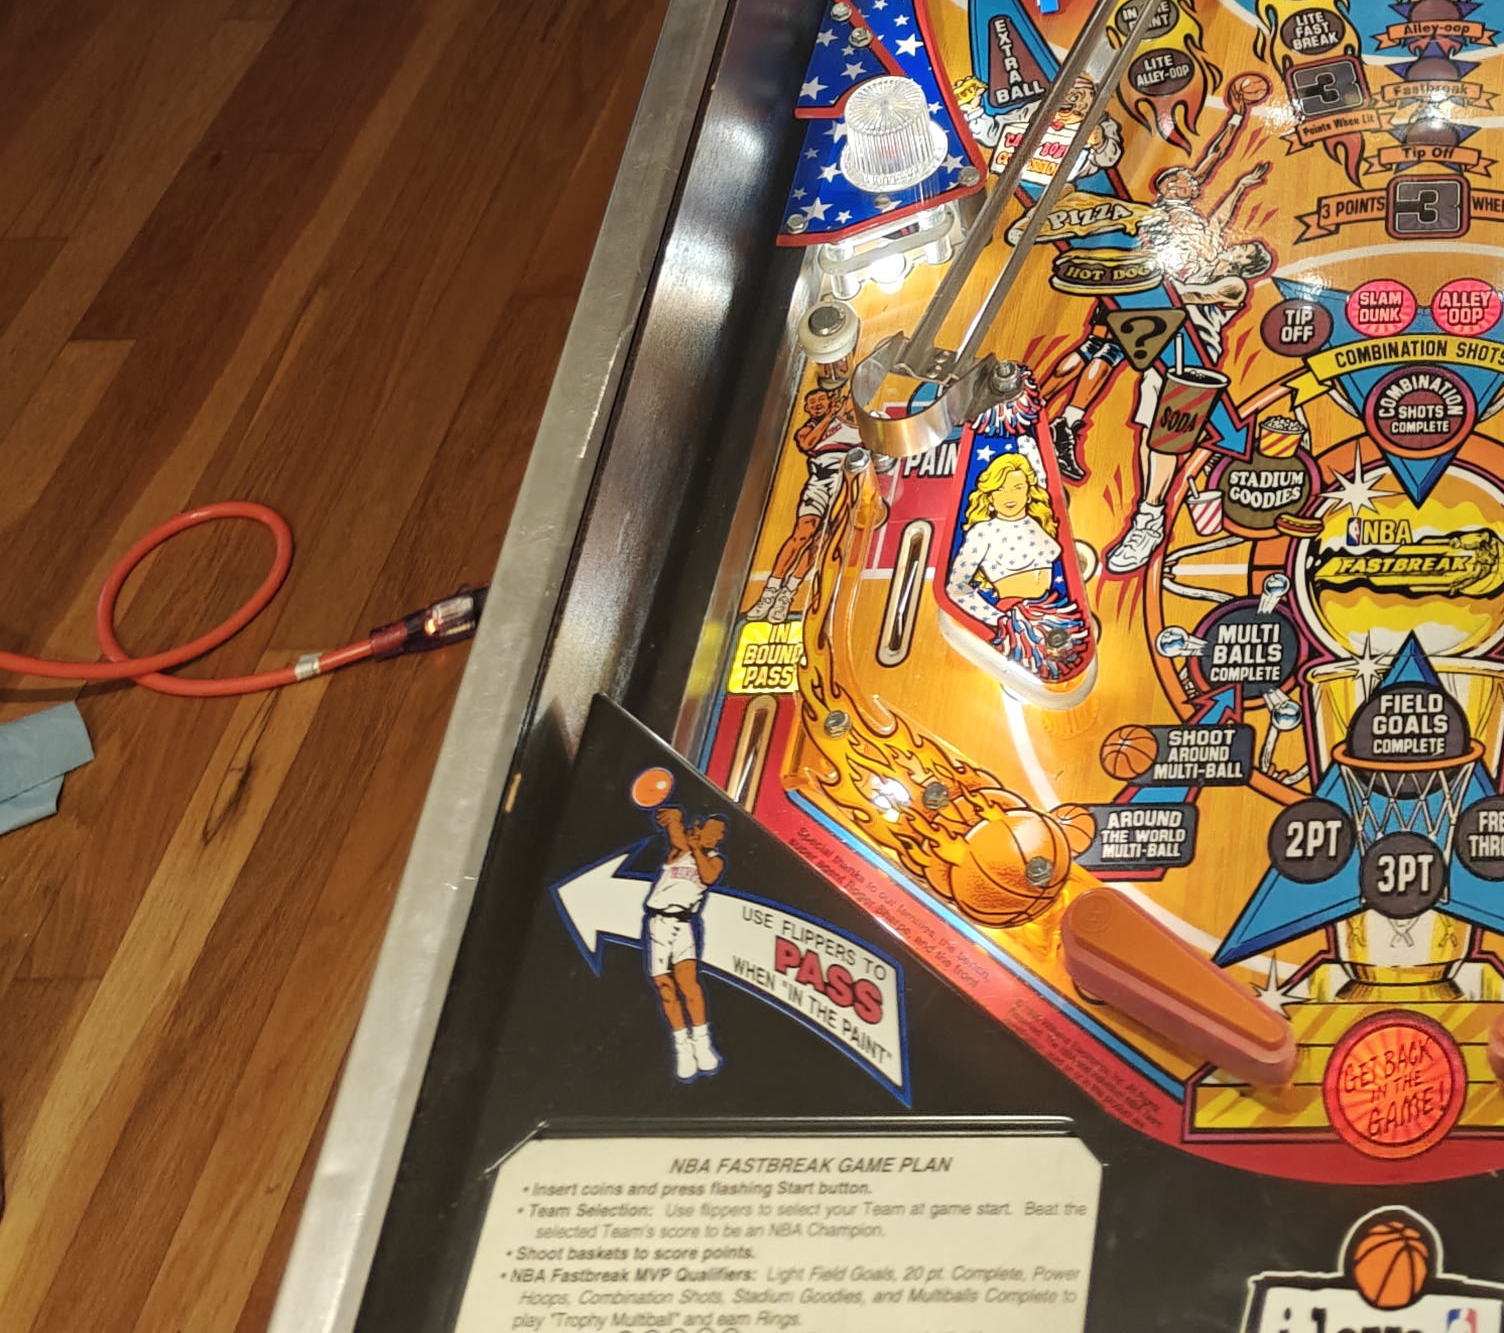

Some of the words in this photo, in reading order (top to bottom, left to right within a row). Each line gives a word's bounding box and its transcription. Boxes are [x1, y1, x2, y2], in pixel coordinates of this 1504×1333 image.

[1295, 11, 1325, 27] LITE
[1295, 22, 1330, 38] FAST
[1292, 32, 1340, 51] BREAK
[1144, 55, 1173, 70] LITE
[1136, 64, 1190, 87] ALLEY-OOP
[996, 77, 1045, 105] BALL
[1402, 146, 1427, 160] Tip
[1430, 145, 1456, 159] Off
[1047, 203, 1133, 230] PIZZA
[1321, 202, 1334, 220] 3
[1337, 196, 1386, 216] POINTS
[1359, 291, 1403, 307] SLAM
[1438, 291, 1492, 308] ALLEY
[1285, 308, 1314, 326] TIP
[1359, 307, 1402, 325] DUNK
[1450, 307, 1484, 325] OOP
[1281, 326, 1314, 344] OFF
[1334, 339, 1448, 369] COMBINATION
[1378, 374, 1464, 419] COMBINATION
[1161, 405, 1200, 432] SODA
[1398, 404, 1444, 420] SHOTS
[1391, 419, 1450, 434] COMPLETE
[1229, 468, 1304, 489] STADIUM
[1230, 485, 1302, 510] GOODIES
[1363, 519, 1412, 545] NBA
[1337, 555, 1474, 575] FASTBREAK
[768, 620, 790, 644] IN
[1216, 623, 1281, 647] MULTI
[1211, 642, 1283, 665] BALLS
[742, 665, 796, 688] PASS
[1210, 663, 1281, 683] COMPLETE
[1380, 693, 1444, 715] FIELD
[1372, 713, 1449, 736] GOALS
[1167, 728, 1236, 748] SHOOT
[1372, 735, 1446, 757] COMPLETE
[1169, 744, 1232, 764] AROUND
[1153, 761, 1245, 782] MULTI-BALL
[1107, 809, 1184, 829] AROUND
[1101, 828, 1129, 844] THE
[1132, 827, 1186, 843] WORLD
[1285, 819, 1344, 859] 2PT
[1101, 840, 1182, 860] MULTI-BALL
[1376, 855, 1435, 894] 3PT
[741, 905, 775, 931] USE
[779, 918, 858, 967] FLIPPERS
[862, 954, 888, 982] TO
[774, 936, 887, 1026] PASS
[669, 1158, 710, 1174] NBA
[716, 1157, 834, 1175] FASTBREAK
[838, 1156, 895, 1174] GAME
[899, 1156, 954, 1174] PLAN
[532, 1182, 578, 1197] Insert
[580, 1182, 622, 1197] coins
[627, 1181, 660, 1197] and
[660, 1184, 707, 1200] press
[709, 1181, 773, 1199] flashing
[776, 1180, 814, 1196] Start
[818, 1180, 873, 1196] button.
[516, 1247, 563, 1262] Shoot
[566, 1246, 628, 1261] baskets
[633, 1246, 650, 1261] to
[652, 1247, 698, 1261] score
[700, 1247, 755, 1264] points.
